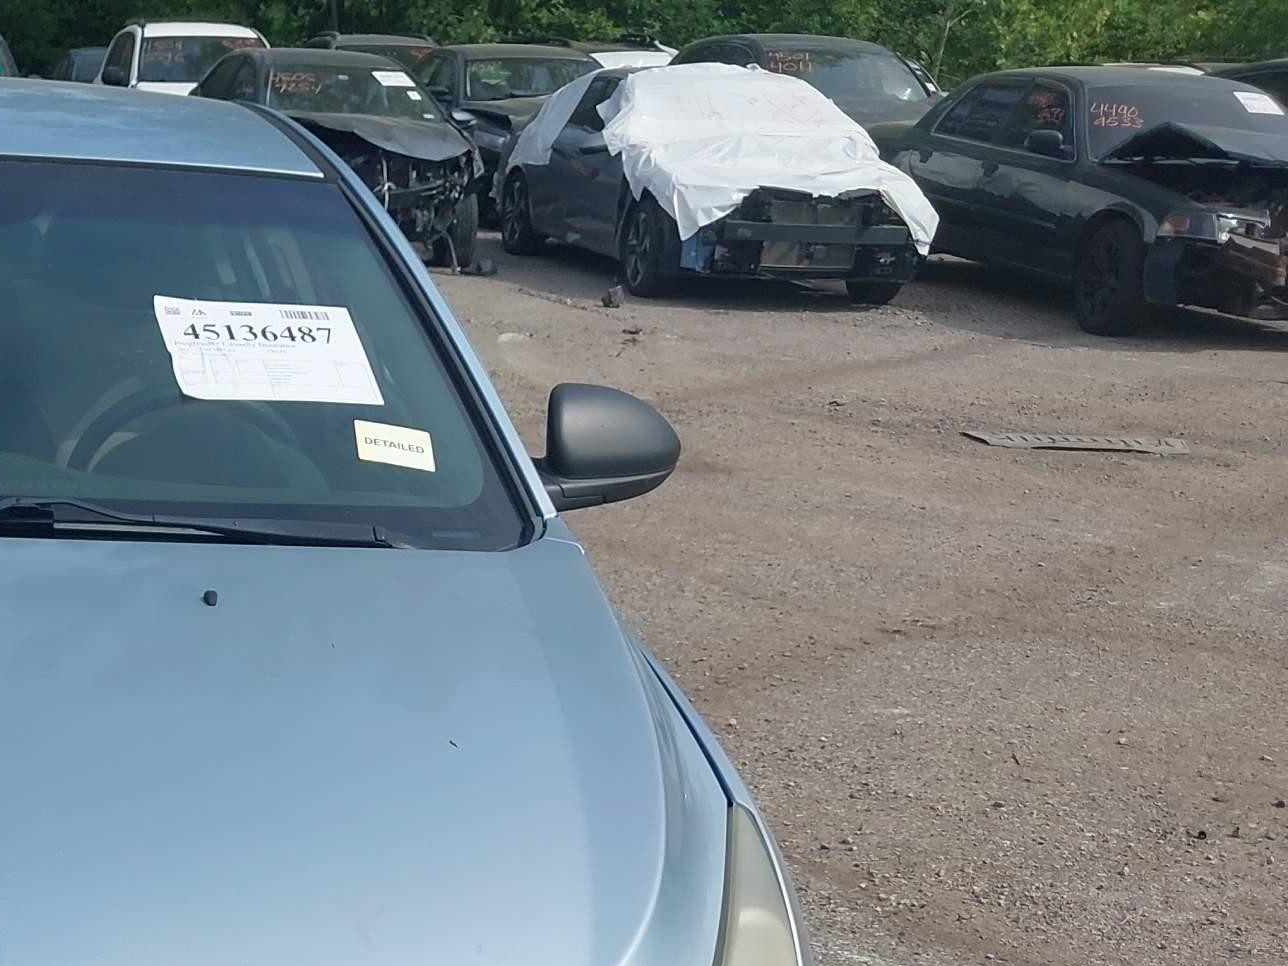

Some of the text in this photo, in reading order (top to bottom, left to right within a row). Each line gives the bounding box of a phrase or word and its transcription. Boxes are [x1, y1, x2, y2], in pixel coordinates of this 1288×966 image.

[1090, 102, 1138, 117] 4490
[183, 323, 332, 344] 45136487
[364, 436, 425, 454] DETAILED
